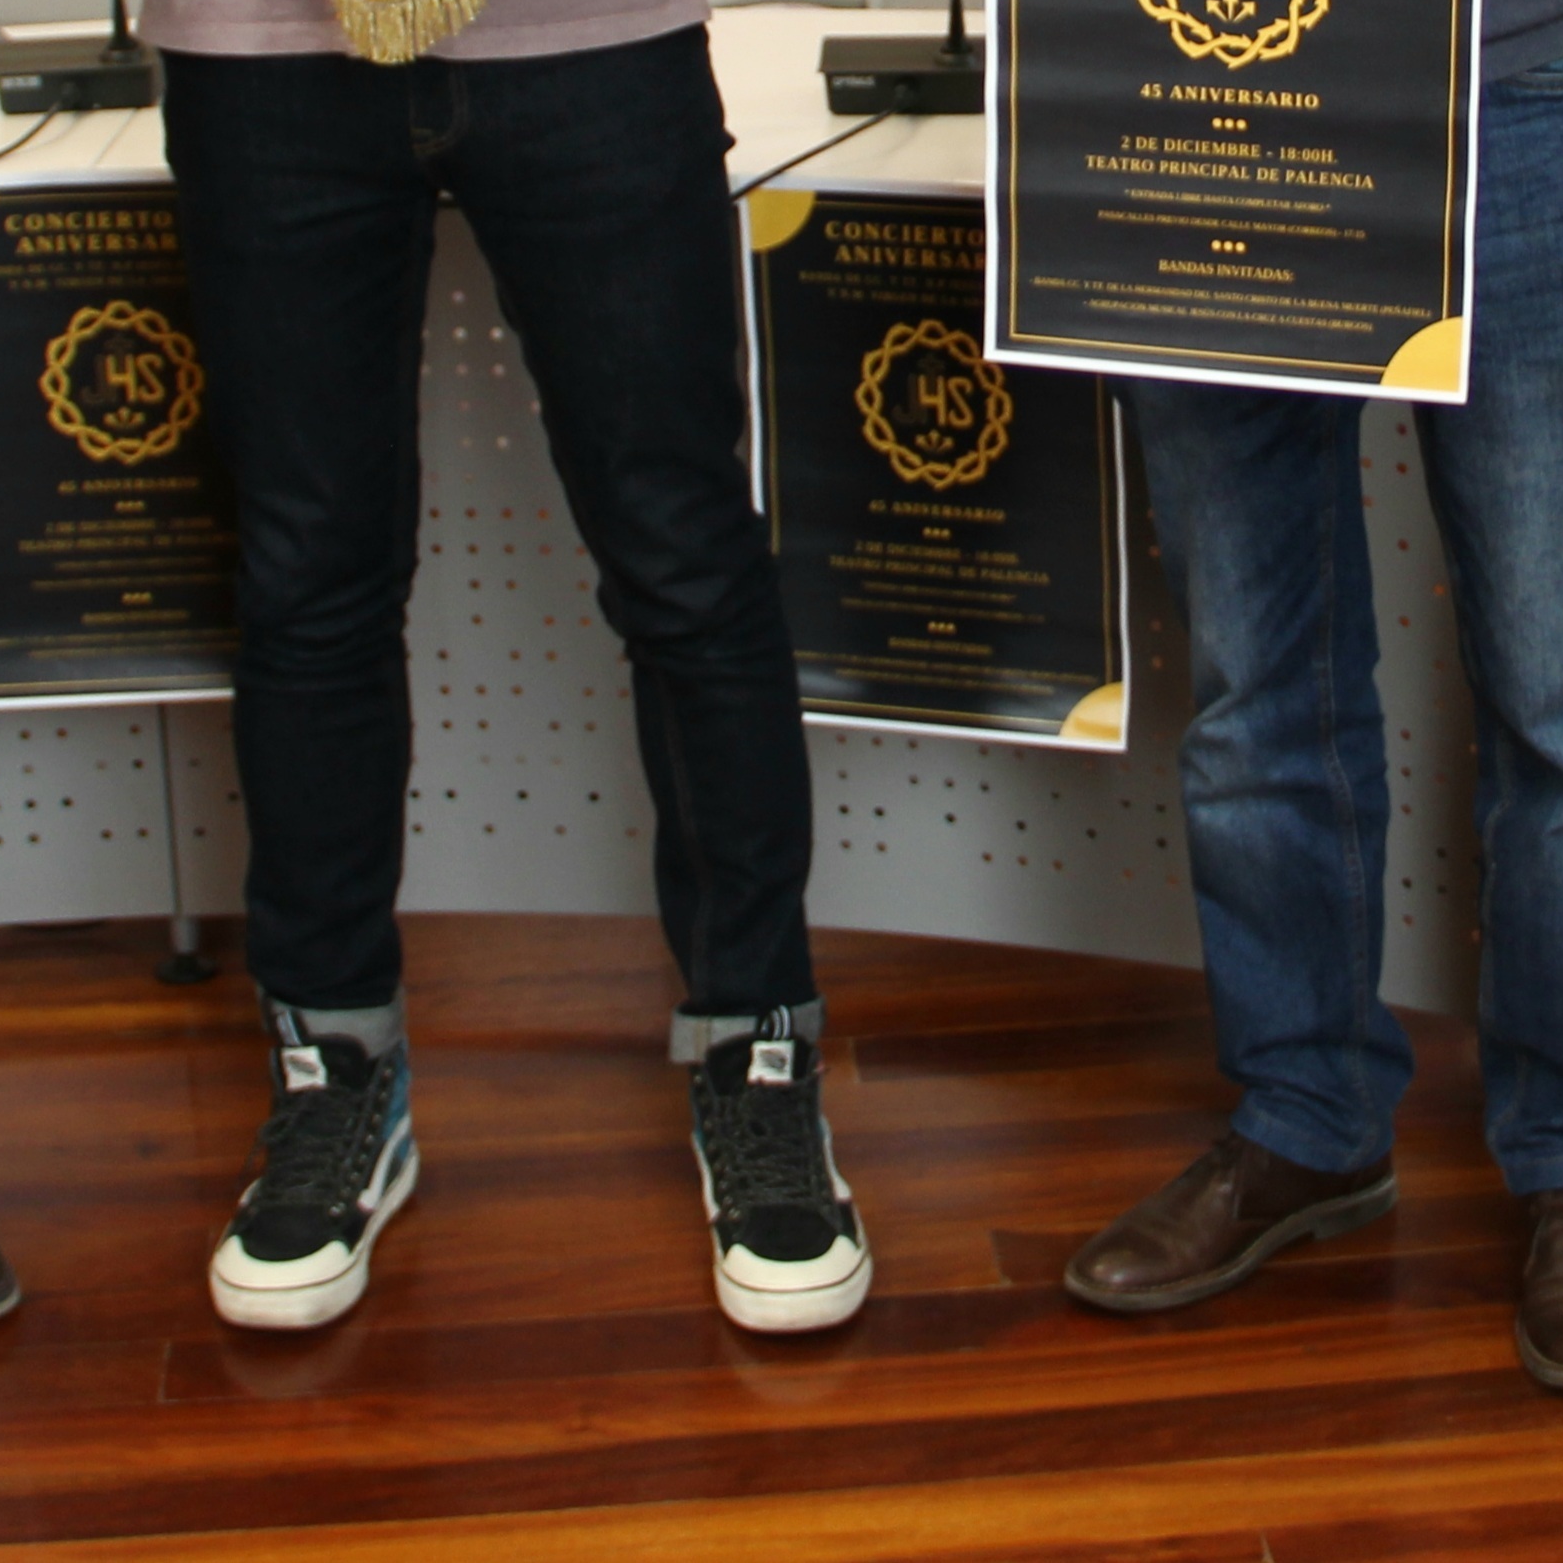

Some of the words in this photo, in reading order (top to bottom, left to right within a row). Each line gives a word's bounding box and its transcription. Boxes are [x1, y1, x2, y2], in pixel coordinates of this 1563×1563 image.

[1139, 83, 1163, 99] 45
[1170, 84, 1320, 109] ANIVERSARIO
[1121, 136, 1130, 149] 2
[1136, 137, 1158, 150] DE
[1164, 138, 1261, 158] DICIEMBRE
[1279, 147, 1338, 164] 18:00H.
[1086, 155, 1154, 172] TEATRO
[1159, 160, 1250, 180] PRINCIPAL
[1257, 167, 1279, 181] DE
[1285, 168, 1374, 189] PALENCIA
[1236, 197, 1290, 209] COMPLETAR
[5, 211, 173, 233] CONCIERTO
[825, 221, 985, 246] CONCIERTO
[16, 234, 177, 254] ANIVERSAR
[835, 245, 985, 270] ANIVERSAR
[1159, 259, 1214, 274] BANDAS
[1217, 265, 1294, 281] INVITADAS:
